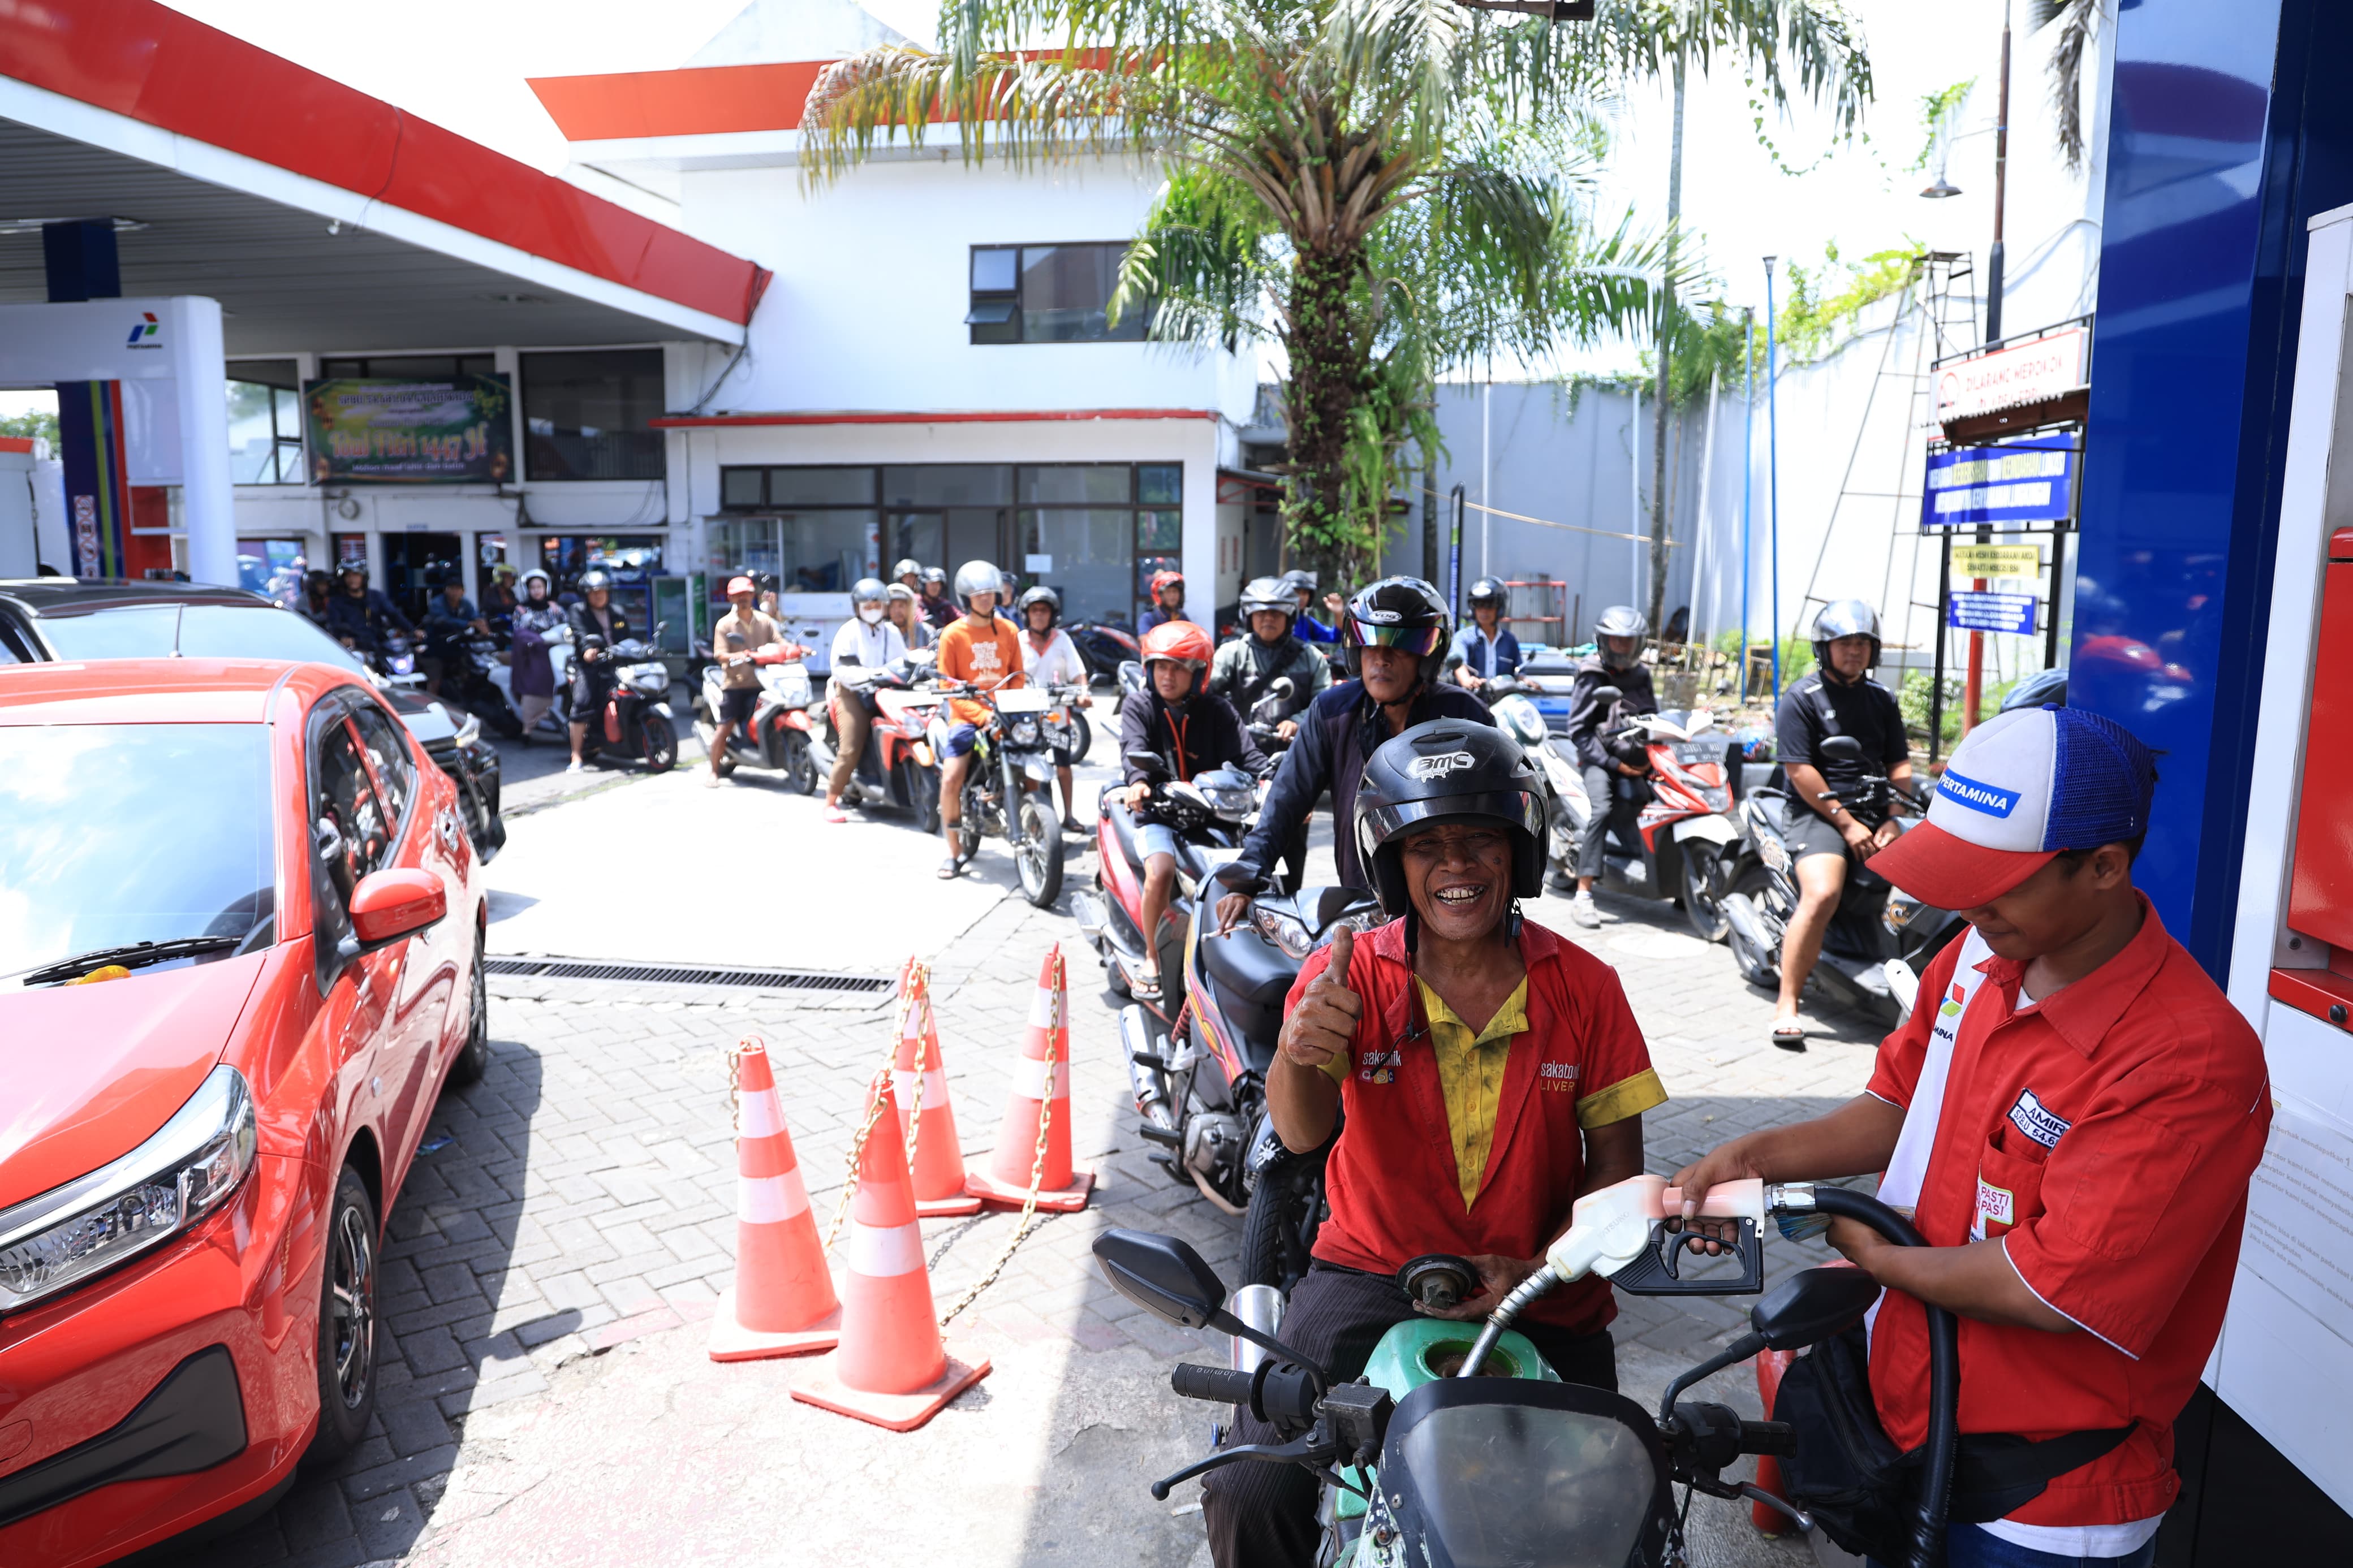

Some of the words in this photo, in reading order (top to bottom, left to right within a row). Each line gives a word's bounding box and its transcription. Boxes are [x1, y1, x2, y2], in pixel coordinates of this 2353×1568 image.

[1540, 1079, 1575, 1092] LIVER
[2032, 1128, 2059, 1146] 54.6
[2276, 1125, 2300, 1141] berhak
[2301, 1137, 2344, 1163] mendapatkan
[2263, 1148, 2286, 1163] perator
[2287, 1157, 2303, 1172] kami
[2304, 1165, 2320, 1181] tidak
[2321, 1173, 2353, 1201] menerapka
[2286, 1170, 2302, 1186] kami
[2303, 1179, 2318, 1195] tidak
[2318, 1188, 2353, 1219] menyebutka
[1981, 1186, 2009, 1207] PASTI
[2256, 1174, 2285, 1193] Operator
[2285, 1187, 2300, 1204] kami
[2300, 1197, 2316, 1213] tidak
[2316, 1206, 2353, 1238] mengucapka
[2249, 1221, 2264, 1236] yang
[2250, 1209, 2278, 1230] Komplain
[2278, 1223, 2291, 1238] bisa
[2291, 1232, 2297, 1242] di
[2297, 1236, 2320, 1259] lakukan
[2320, 1254, 2335, 1272] pada
[2336, 1263, 2350, 1280] saat
[2249, 1232, 2261, 1245] Jika
[2261, 1241, 2276, 1255] tidak
[2276, 1251, 2286, 1263] ada
[2326, 1286, 2343, 1303] maka
